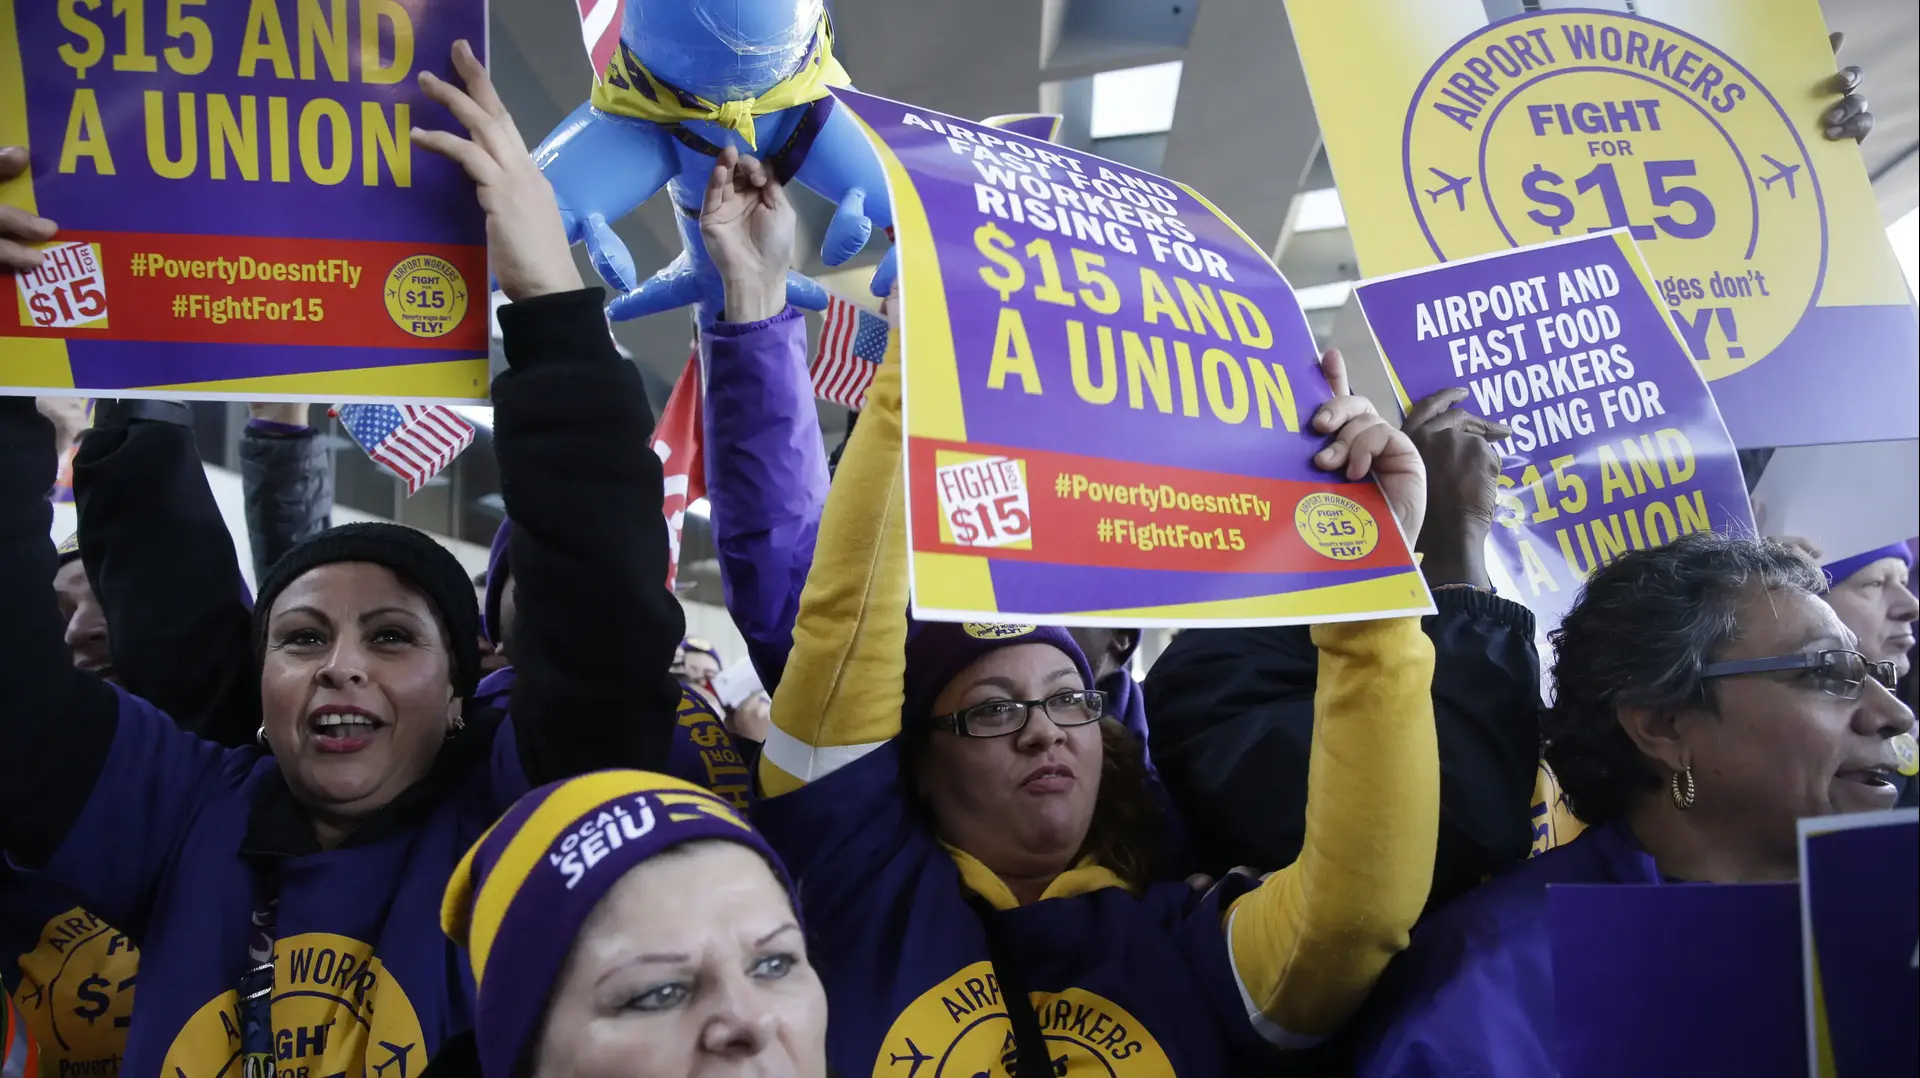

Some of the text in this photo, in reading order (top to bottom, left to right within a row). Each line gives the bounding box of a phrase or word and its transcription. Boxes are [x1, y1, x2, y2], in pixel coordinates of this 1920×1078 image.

[57, 0, 415, 85] $15 AND
[1433, 24, 1746, 131] AIRPORT WORKERS
[58, 88, 412, 188] A UNION
[1527, 99, 1662, 136] FIGHT
[902, 113, 1178, 201] AIRPORT AND
[1587, 139, 1634, 158] FOR
[946, 136, 1178, 217] FAST FOOD
[972, 160, 1197, 243] WORKERS
[1521, 159, 1717, 241] $15
[974, 183, 1235, 283] RISING FOR
[79, 248, 96, 273] FOR
[131, 252, 362, 287] #PovertyDoesntFly
[393, 258, 459, 282] AIRPORT WORKERS
[411, 275, 440, 285] FIGHT
[972, 222, 1274, 350] $15 AND
[29, 276, 107, 327] $15
[172, 295, 324, 325] #FightFor15
[406, 288, 445, 309] $15
[1415, 263, 1621, 342] AIRPORT AND
[1654, 270, 1770, 306] ges don't
[412, 321, 443, 333] FLY!
[1447, 304, 1621, 377] FAST FOOD
[1669, 307, 1746, 360] Y!
[986, 307, 1300, 433] A UNION
[1469, 344, 1635, 417] WORKERS
[1490, 380, 1665, 456] ISING FOR
[940, 460, 1015, 503] FIGHT
[1054, 472, 1271, 521] #PovertyDoesntFly
[1323, 495, 1361, 513] WORKERS
[1494, 428, 1696, 535] $15 AND
[951, 495, 1031, 546] $15
[1097, 523, 1246, 552] #FightFor15
[1316, 521, 1356, 536] $15
[1516, 490, 1712, 596] A UNION
[1331, 546, 1363, 556] FLY!
[550, 806, 628, 866] LOCAL
[560, 804, 655, 889] SEIU
[941, 973, 1000, 1024] AIRP
[1033, 998, 1143, 1060] ORKERS
[60, 1055, 123, 1078] Povert
